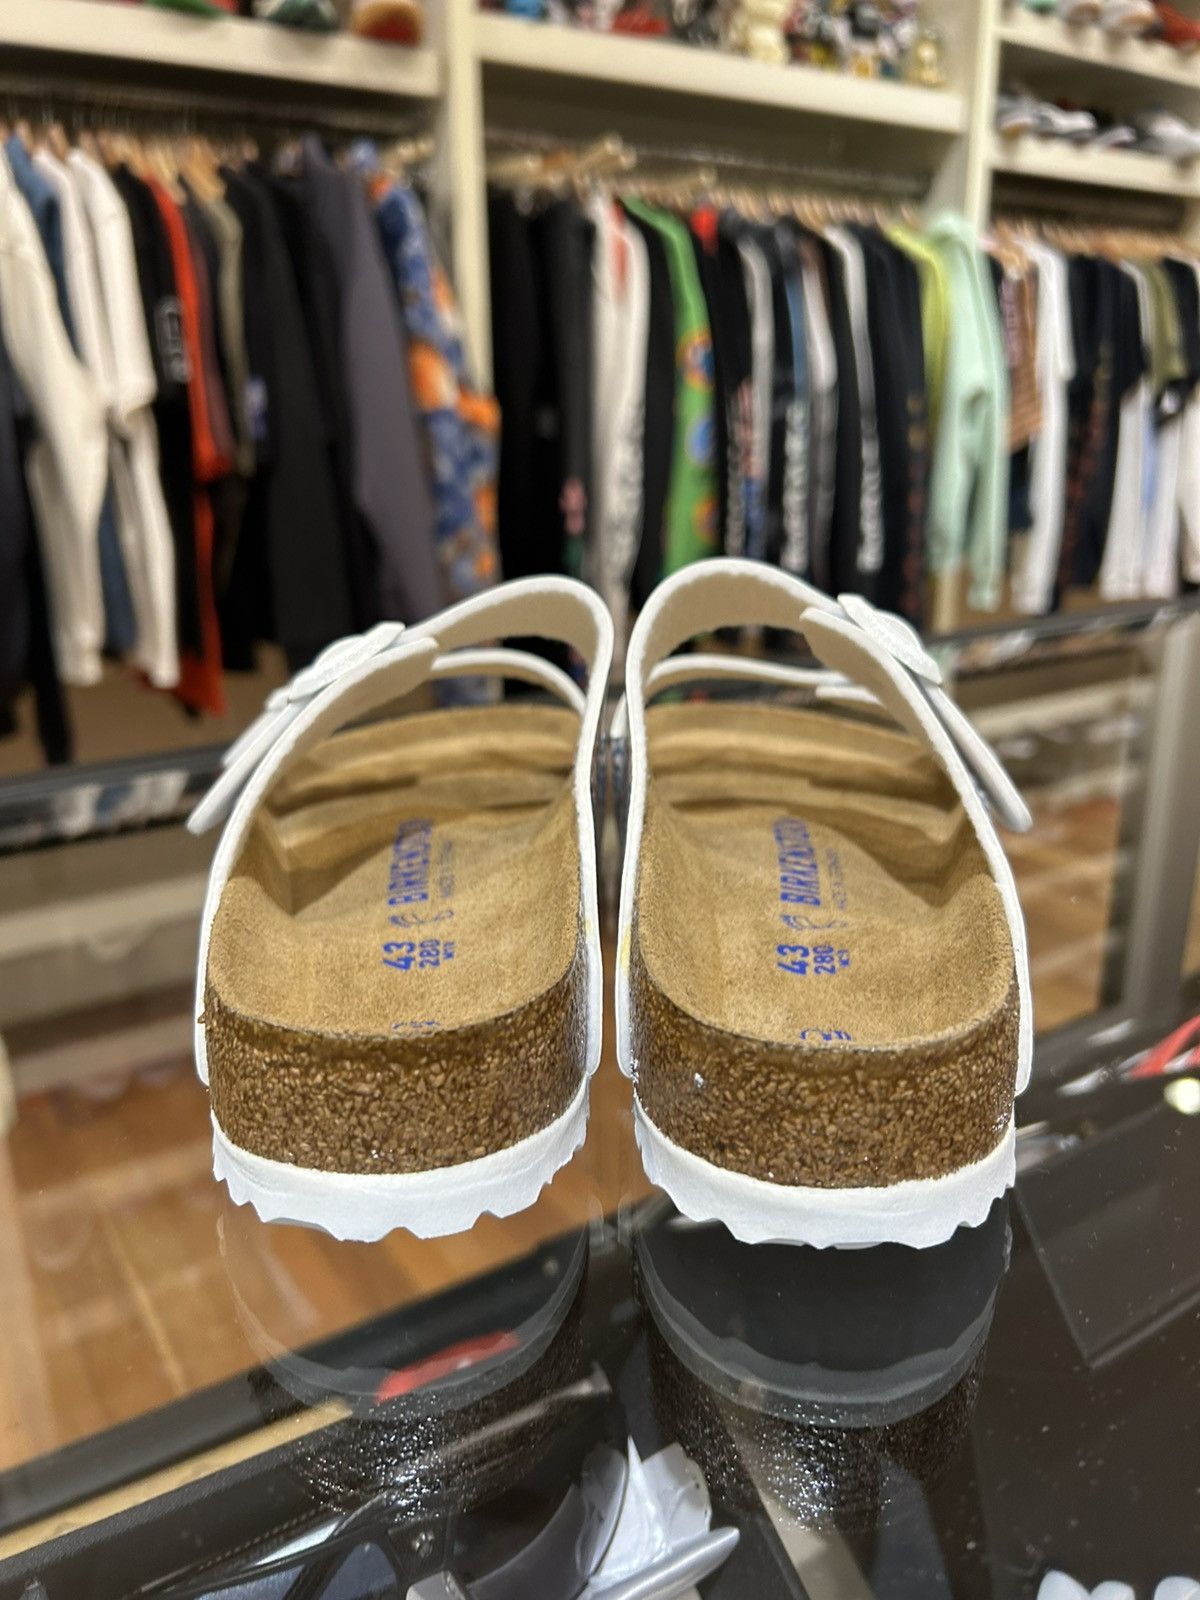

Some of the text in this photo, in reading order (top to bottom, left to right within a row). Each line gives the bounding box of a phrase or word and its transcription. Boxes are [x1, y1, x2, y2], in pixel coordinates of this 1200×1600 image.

[383, 942, 415, 971] 43
[419, 939, 440, 968] 280
[776, 944, 810, 975] 43
[812, 944, 836, 974] 280
